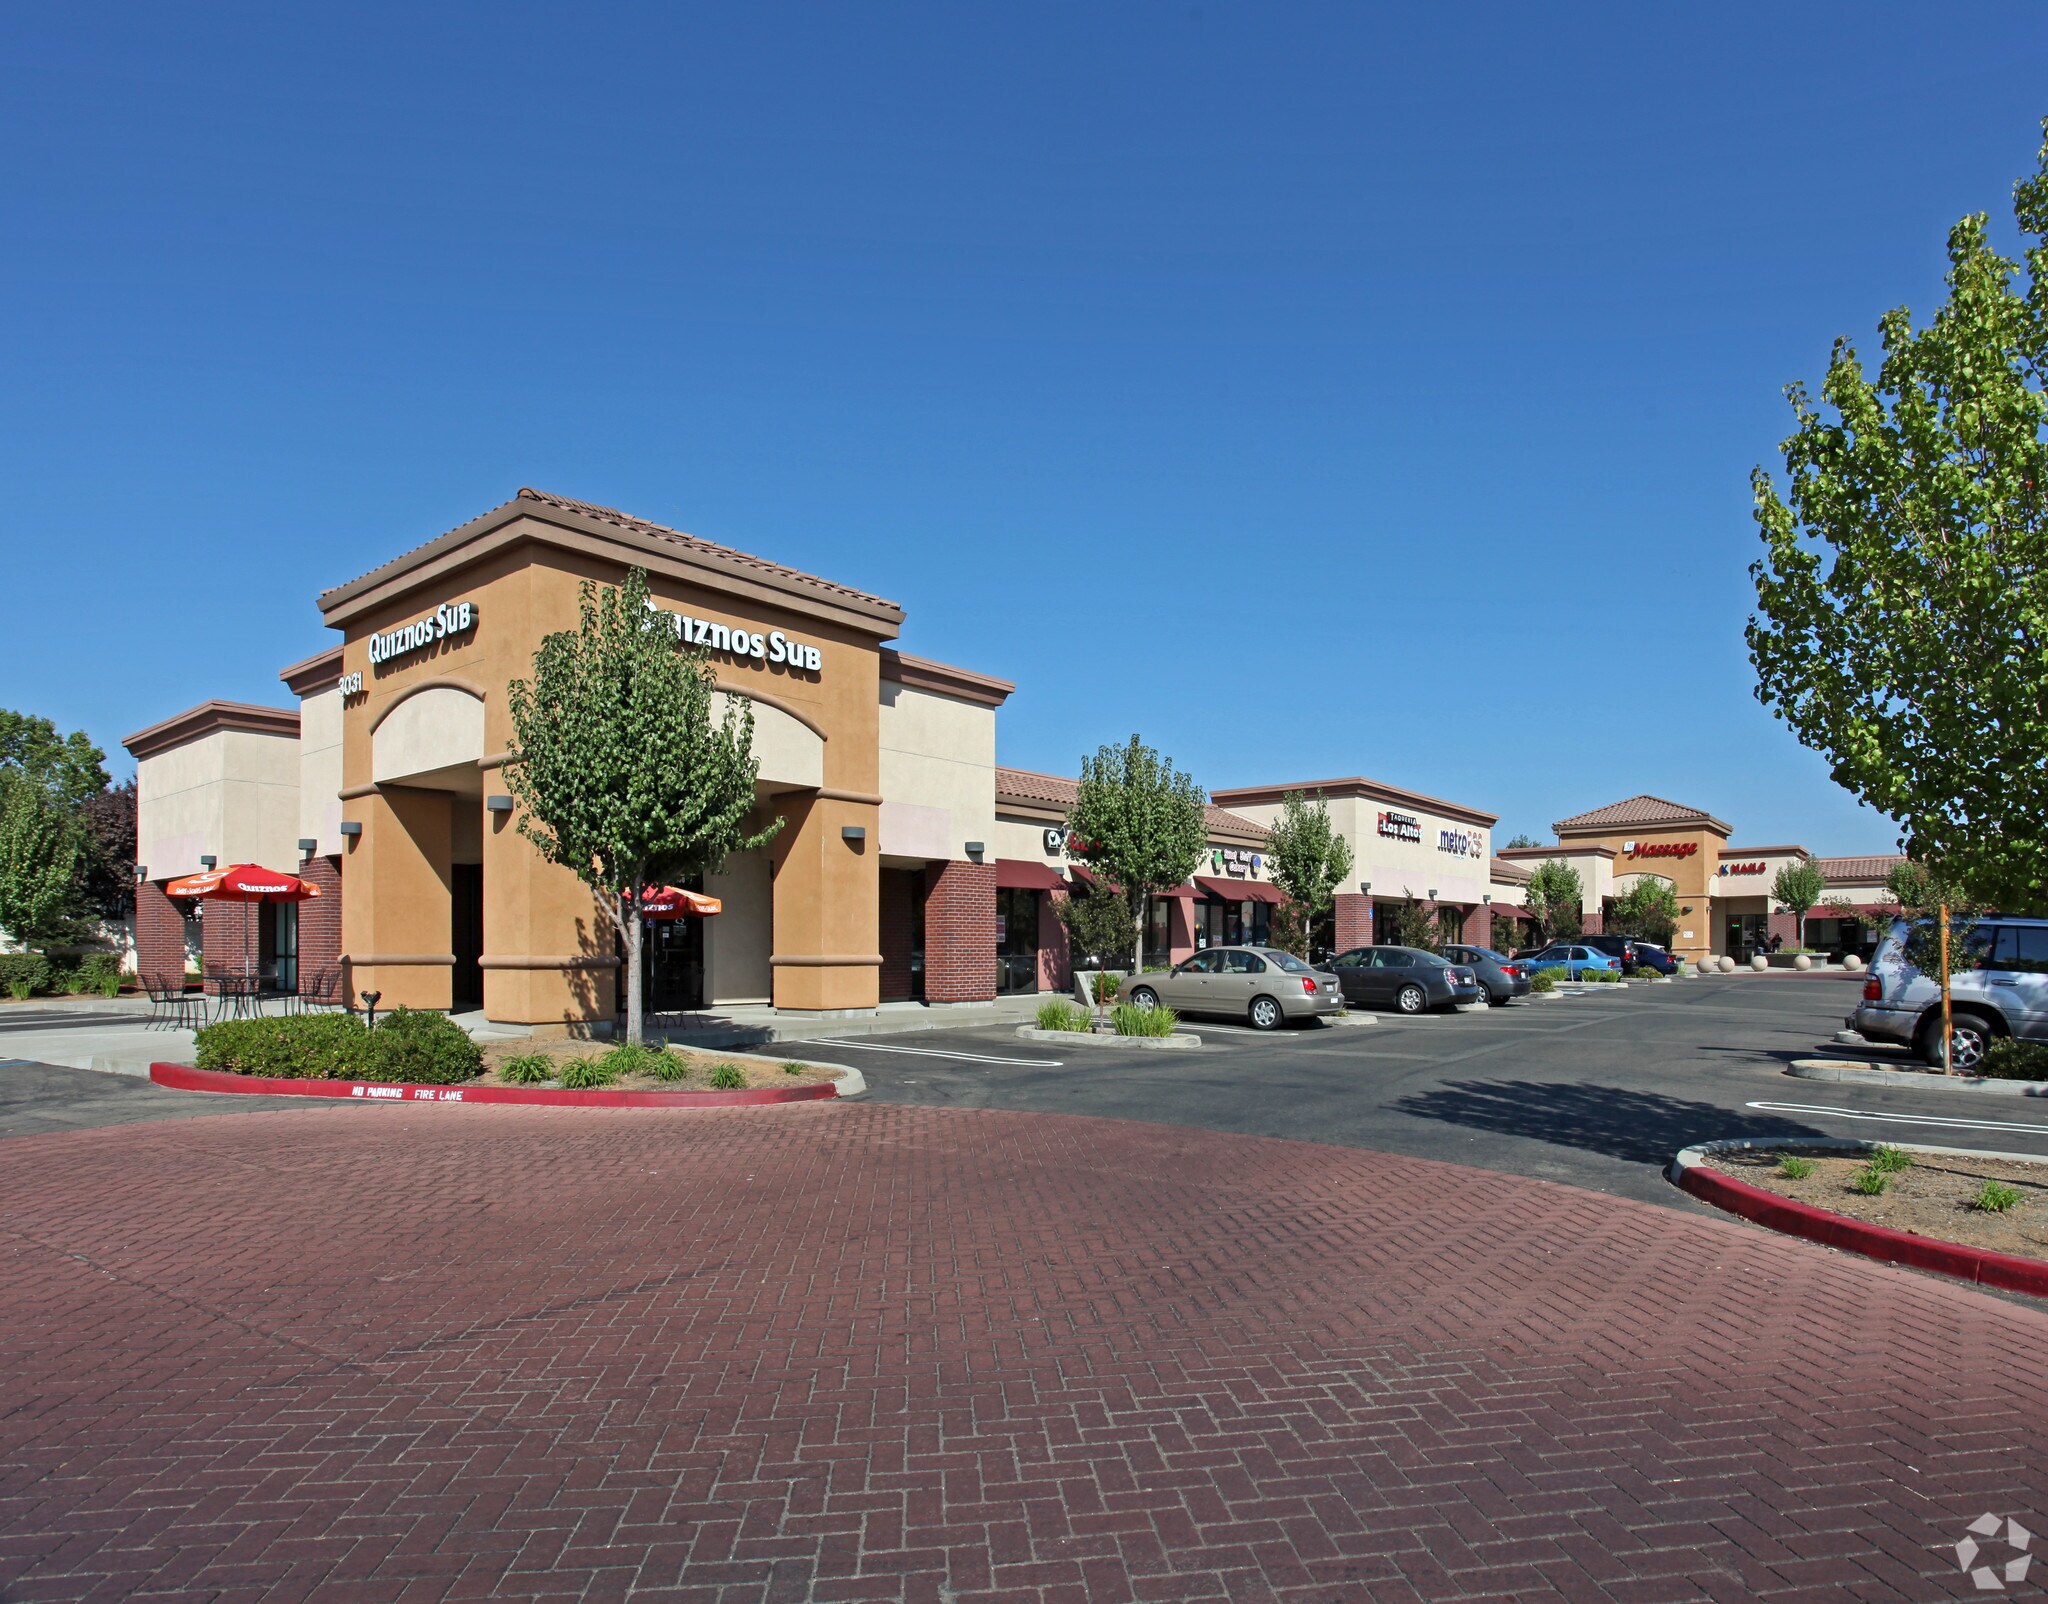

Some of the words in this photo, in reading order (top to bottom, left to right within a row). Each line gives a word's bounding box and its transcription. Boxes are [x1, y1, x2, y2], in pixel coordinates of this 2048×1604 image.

[368, 616, 434, 664] Quiznos
[338, 671, 363, 698] 3031
[1390, 813, 1417, 826] TAQUERIA
[1383, 820, 1398, 834] Los
[1400, 823, 1424, 839] Altos
[1629, 842, 1698, 859] Massage
[1720, 864, 1729, 875] K
[1731, 861, 1767, 875] NAILS
[237, 882, 288, 893] Quiznos
[352, 1086, 364, 1096] NO
[368, 1087, 403, 1098] PARKING
[414, 1089, 436, 1100] FIRE
[439, 1091, 463, 1100] LANE
